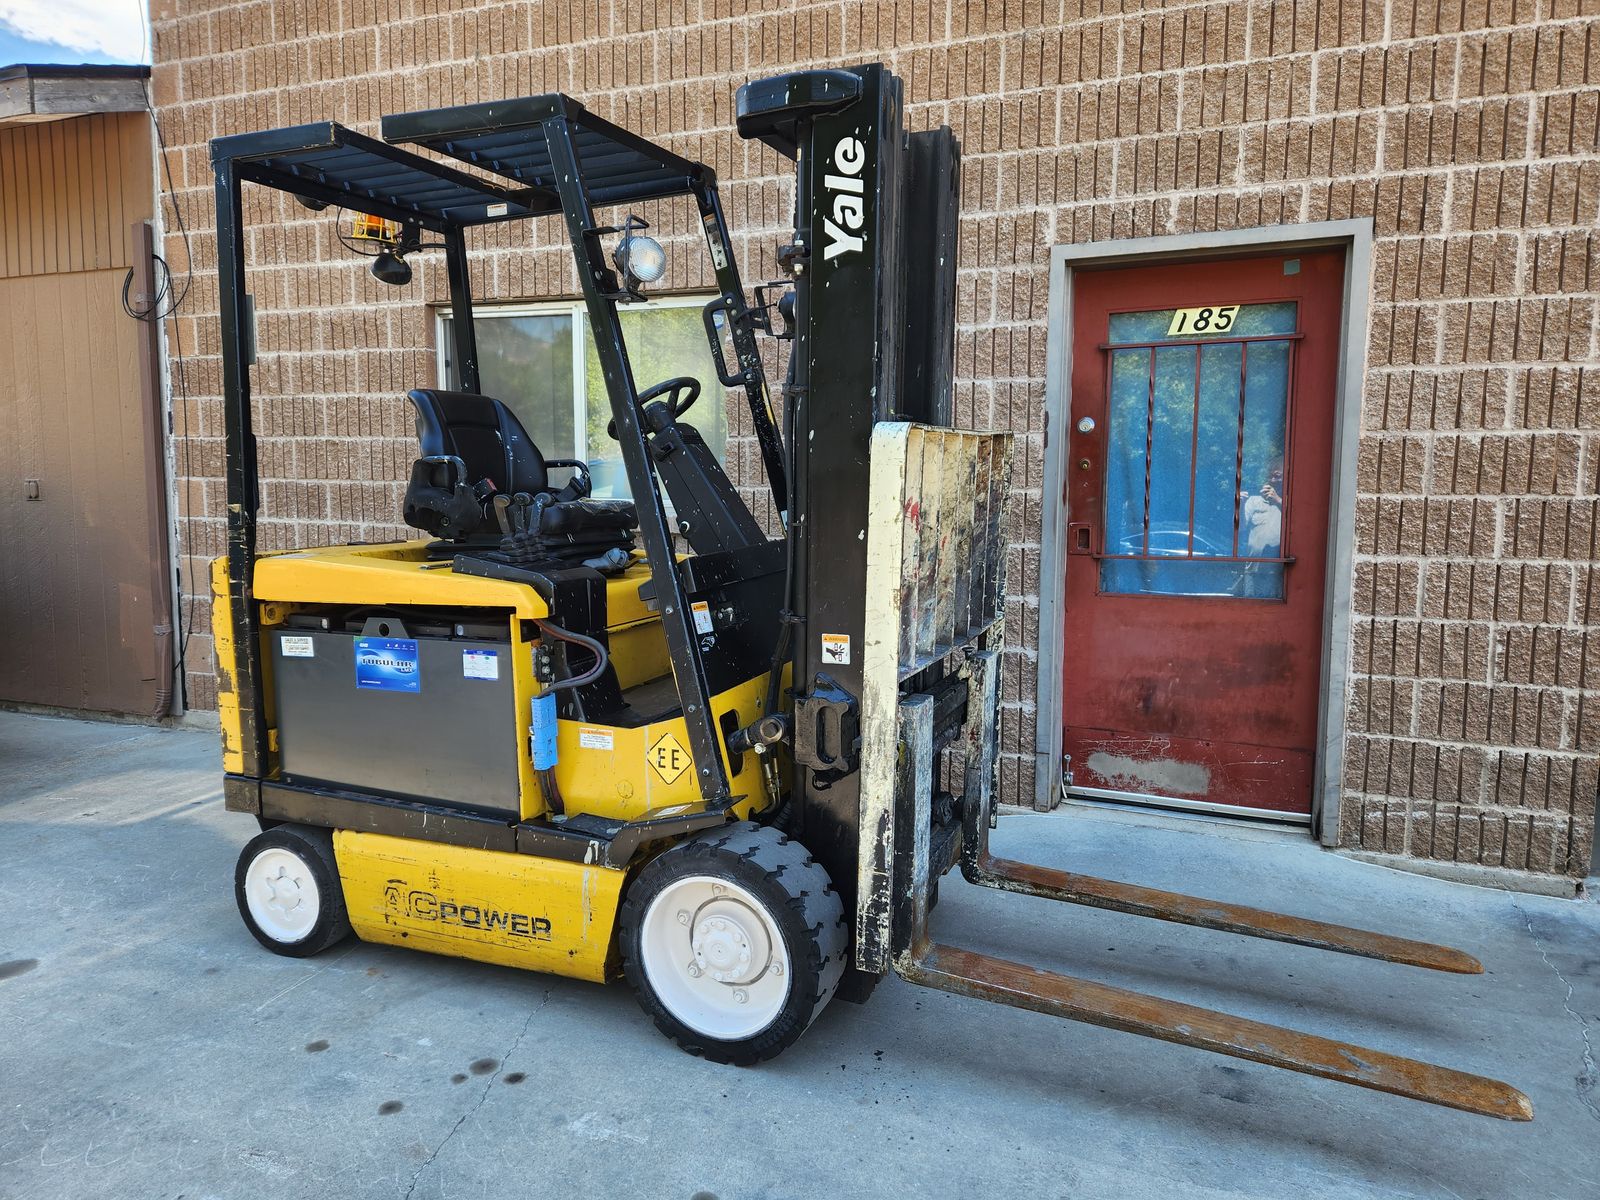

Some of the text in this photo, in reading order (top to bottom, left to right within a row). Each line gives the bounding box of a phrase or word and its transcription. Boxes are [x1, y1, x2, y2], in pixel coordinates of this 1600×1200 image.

[824, 136, 865, 260] Yale
[1177, 308, 1235, 332] 185
[361, 657, 414, 668] TUBULAR
[657, 747, 680, 770] EE
